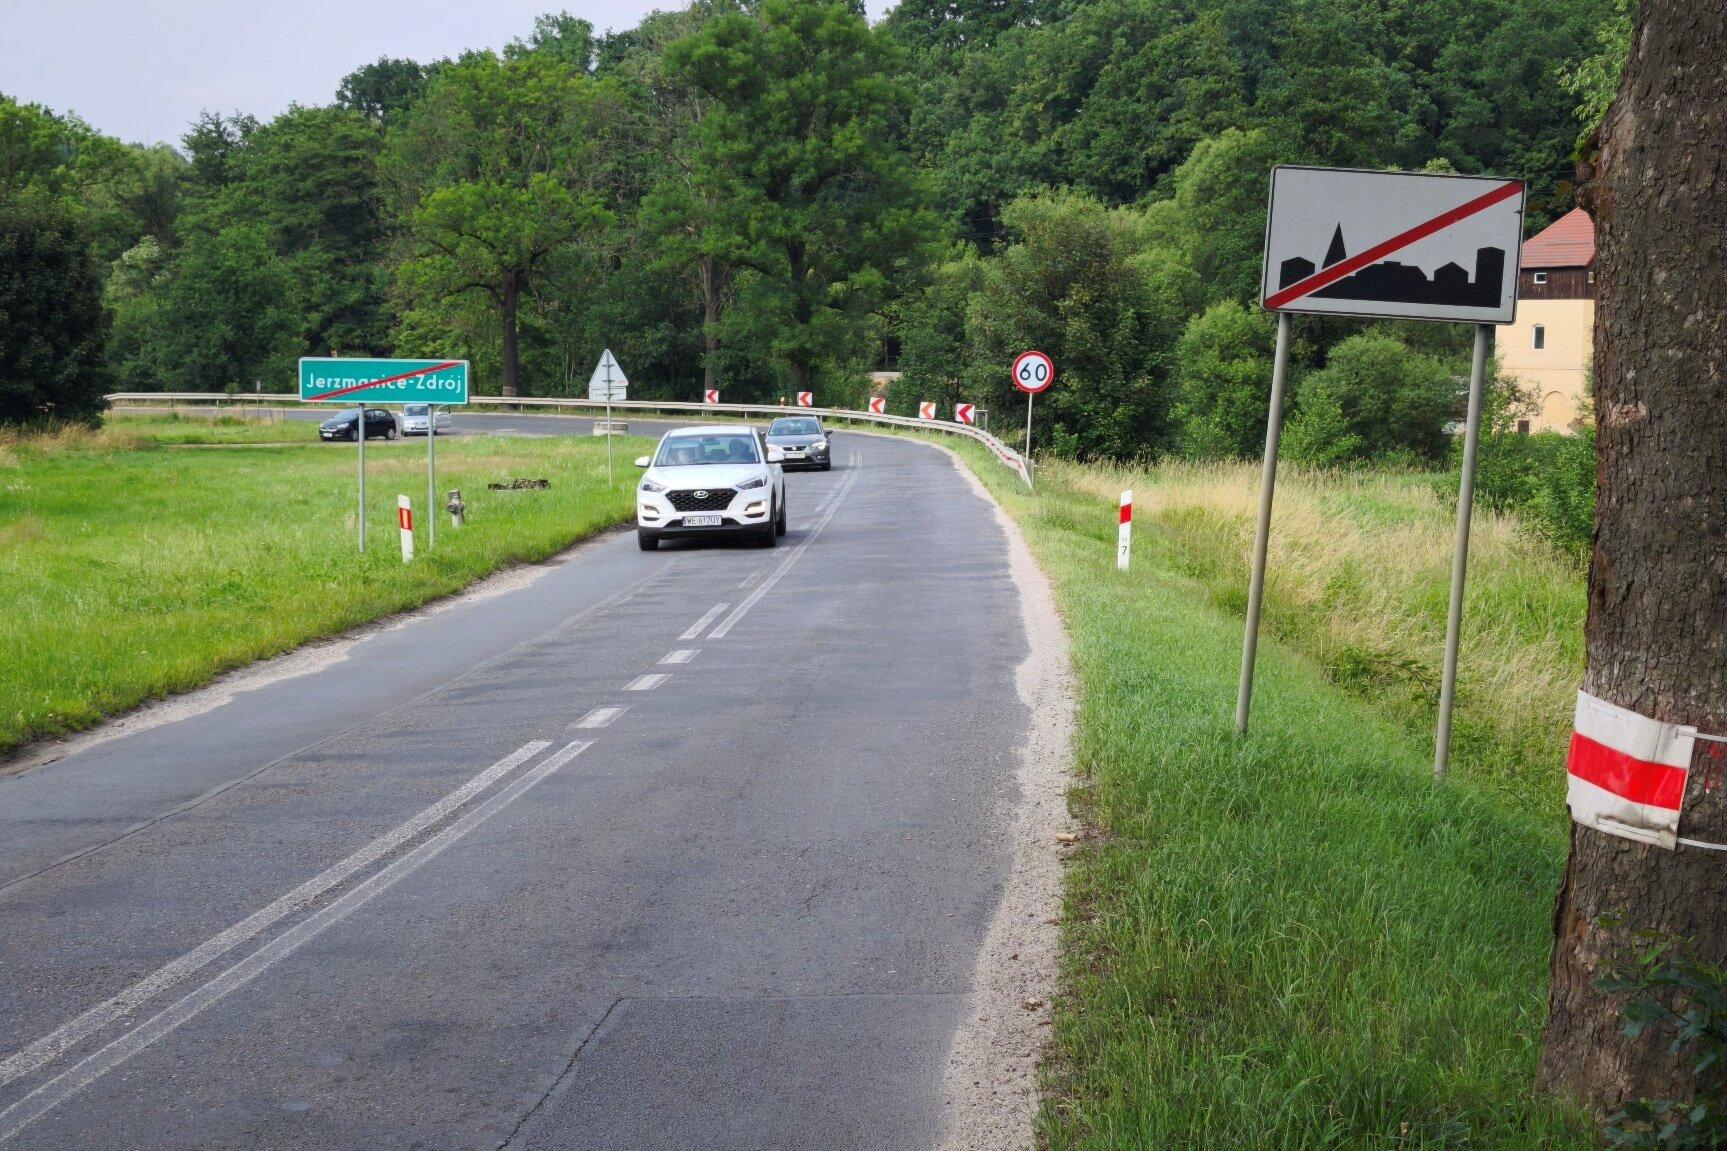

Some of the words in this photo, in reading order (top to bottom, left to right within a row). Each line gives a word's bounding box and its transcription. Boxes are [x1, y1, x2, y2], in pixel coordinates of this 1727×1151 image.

[1020, 362, 1048, 382] 60
[306, 373, 462, 394] Jerzmanice-Zdrój
[1121, 545, 1128, 556] 7
